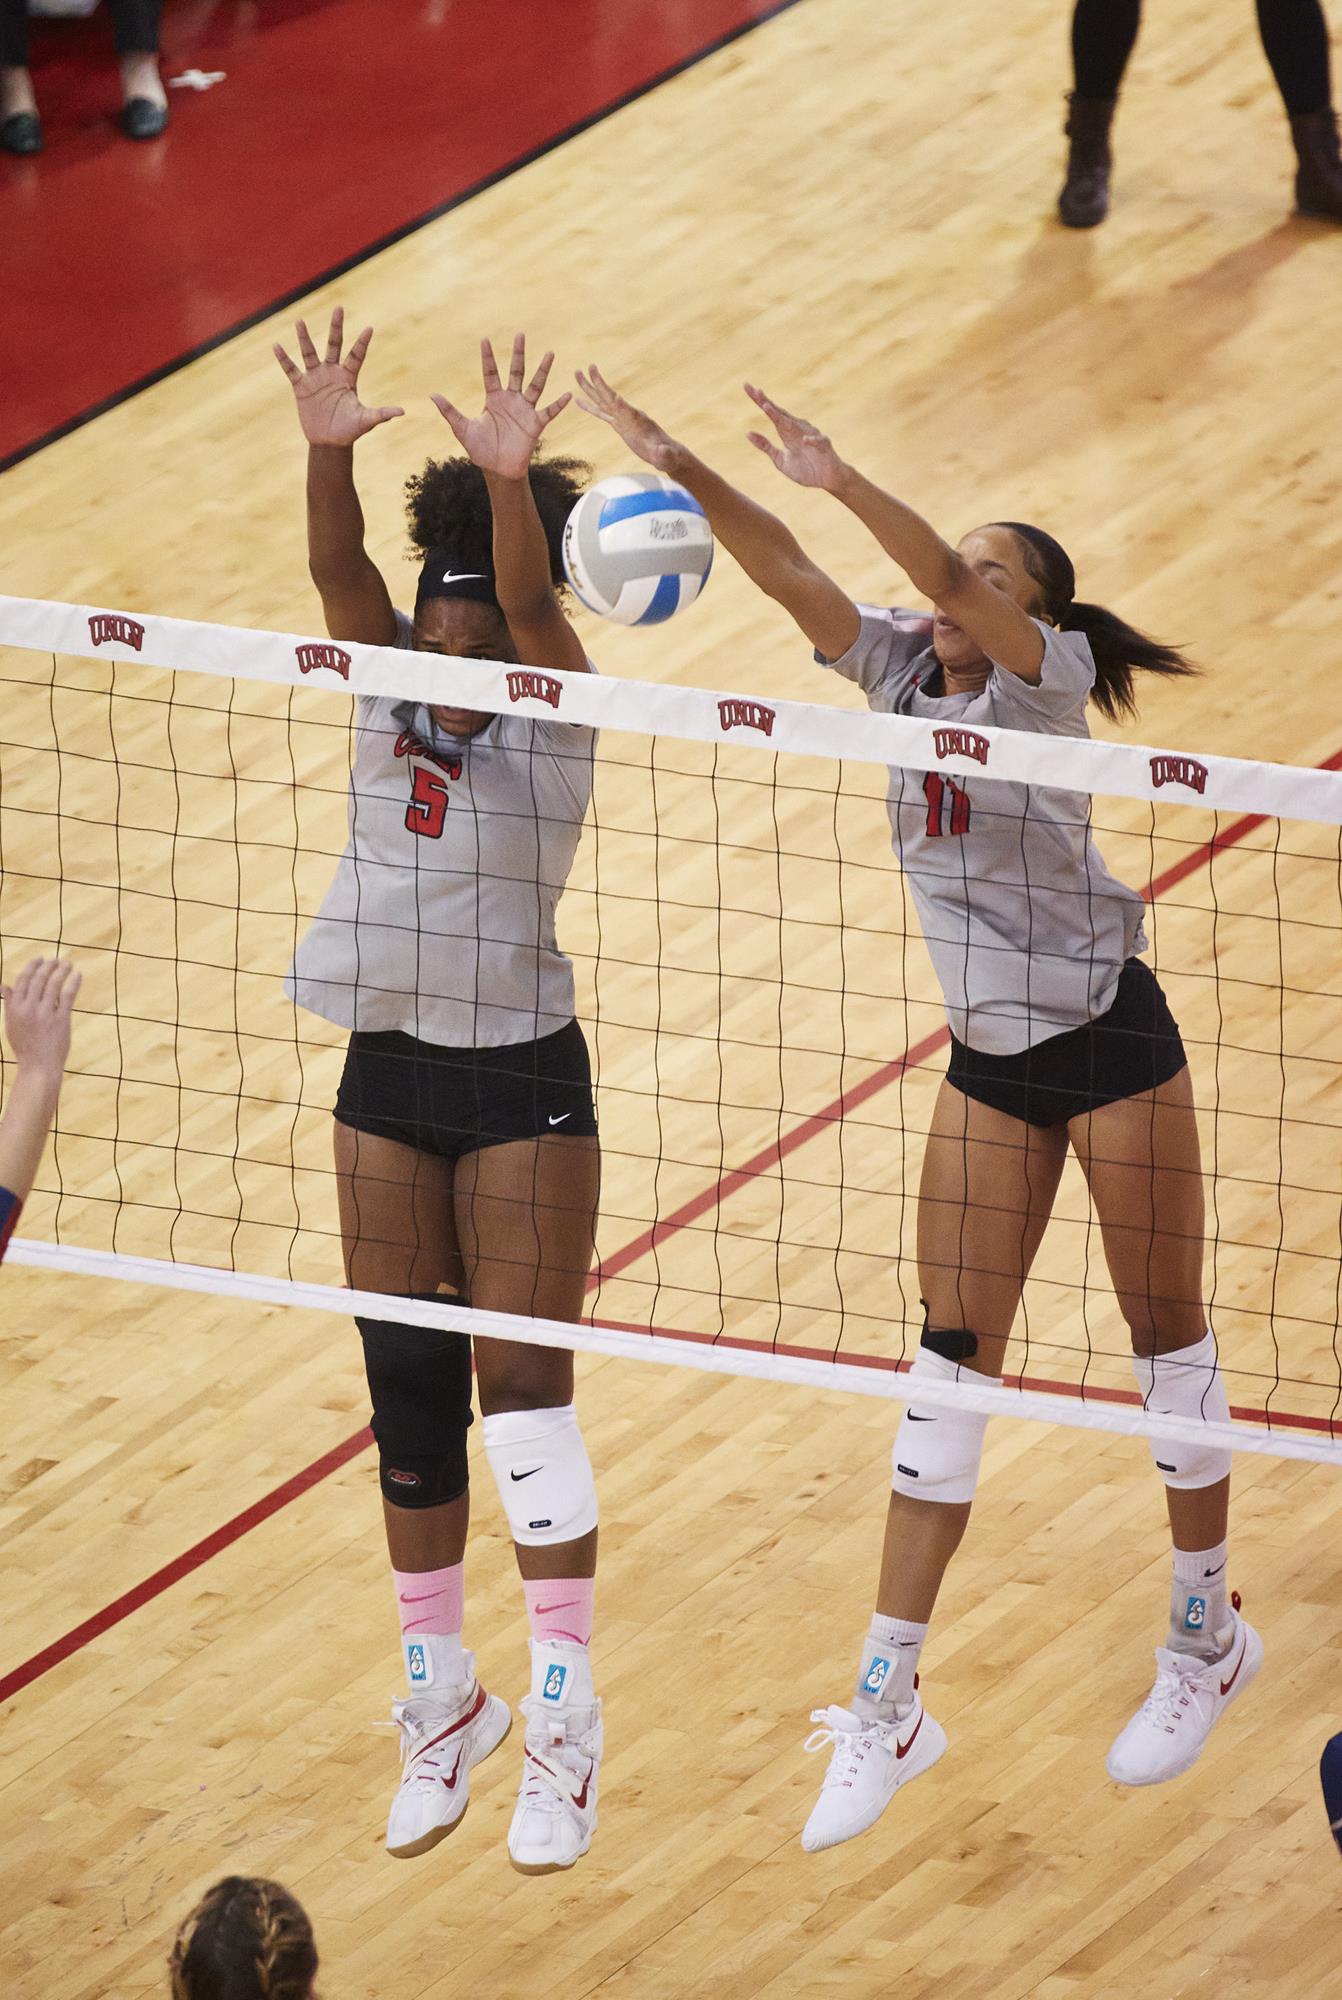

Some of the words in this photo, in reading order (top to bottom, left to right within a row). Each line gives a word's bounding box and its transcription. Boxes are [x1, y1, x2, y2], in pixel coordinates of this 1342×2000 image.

[88, 614, 145, 651] UNLV
[295, 643, 352, 680] UNLV
[506, 670, 563, 708] UNLV
[717, 699, 776, 736] UNLV
[932, 728, 990, 765] UNLV
[1149, 755, 1208, 794] UNLV
[405, 766, 449, 839] 5
[922, 771, 971, 837] 11
